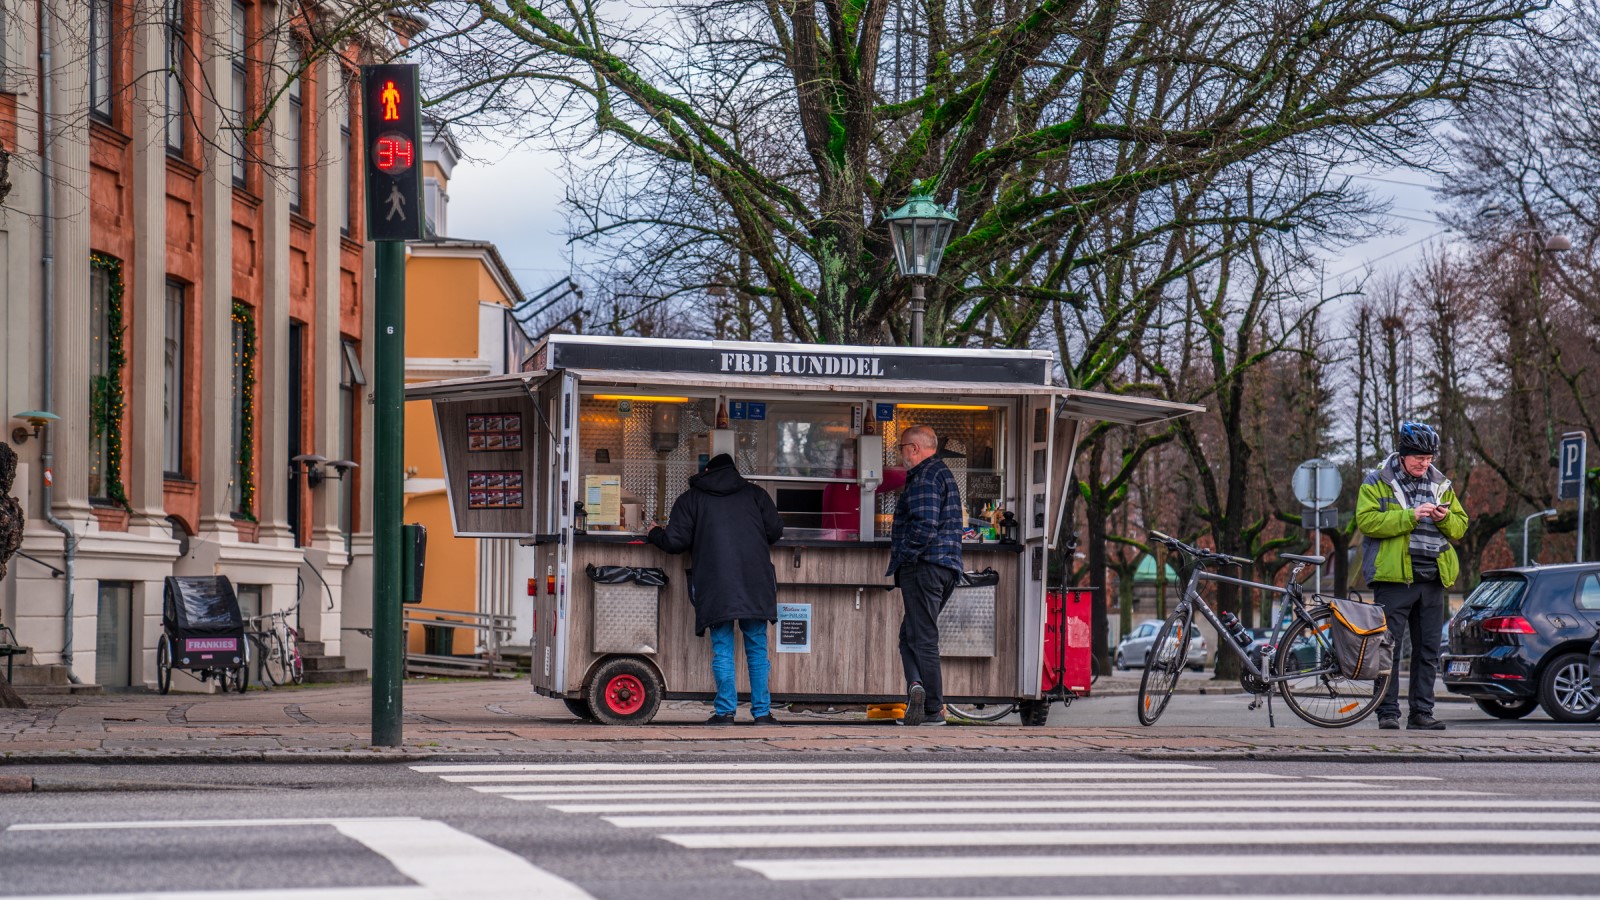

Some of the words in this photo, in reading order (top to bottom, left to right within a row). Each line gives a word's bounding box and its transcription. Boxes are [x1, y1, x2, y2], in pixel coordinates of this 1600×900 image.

[378, 138, 412, 168] 34
[387, 326, 394, 334] 6
[720, 352, 768, 373] FRB
[774, 354, 885, 377] RUNDDEL
[1565, 443, 1580, 477] P
[188, 640, 234, 649] FRANKIES
